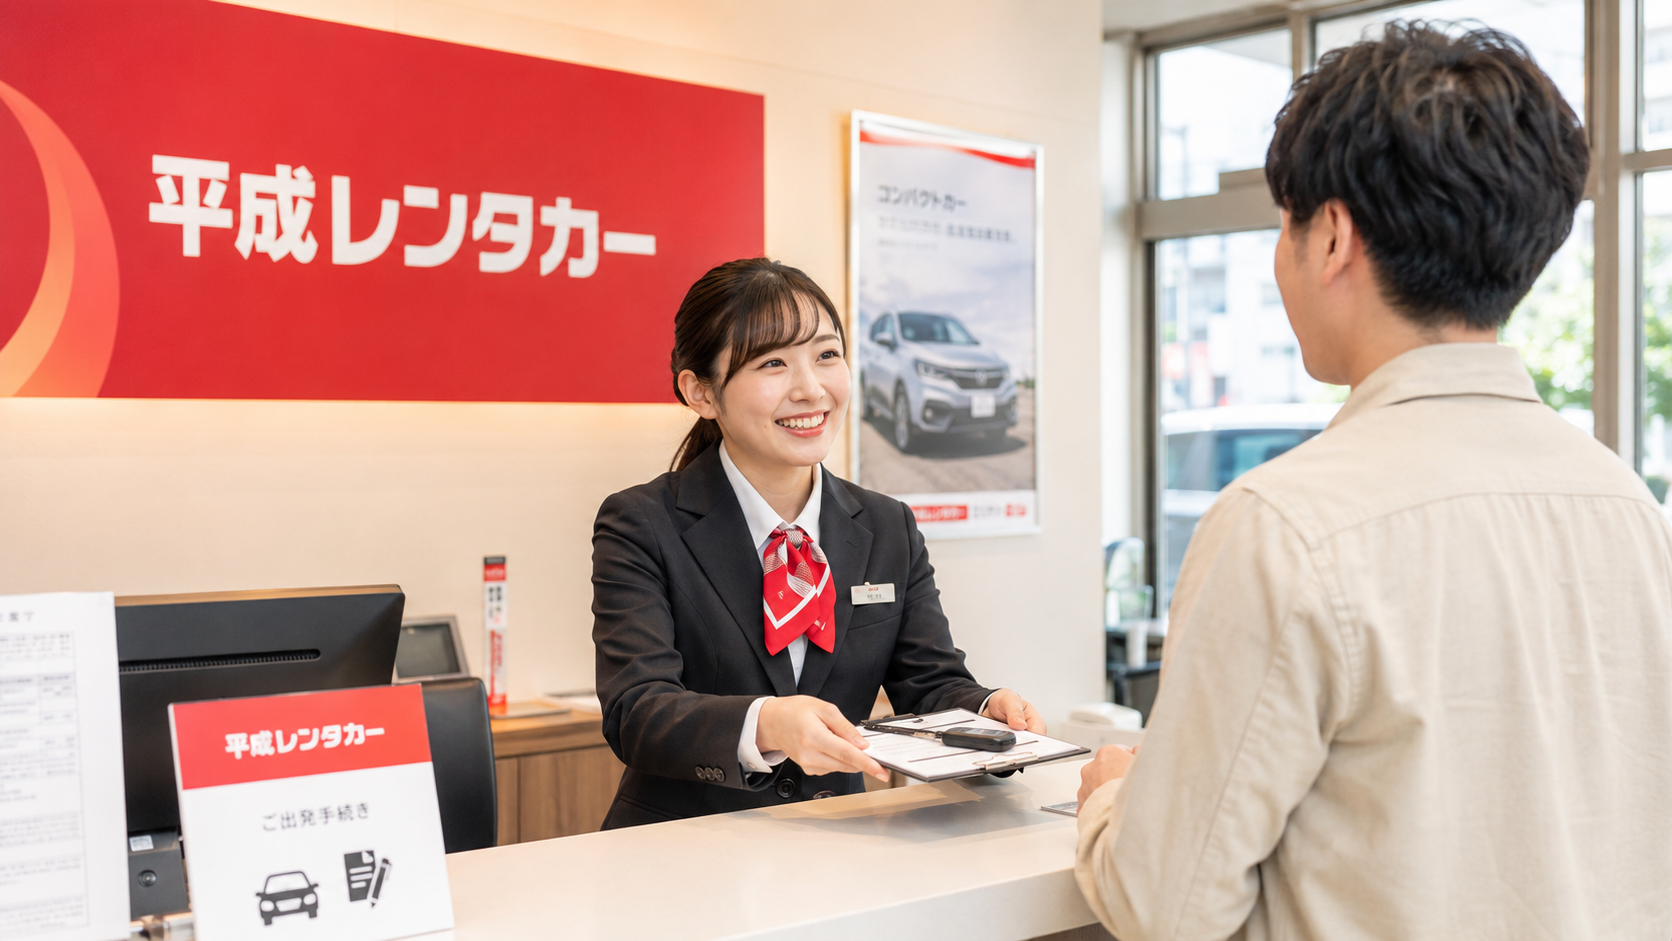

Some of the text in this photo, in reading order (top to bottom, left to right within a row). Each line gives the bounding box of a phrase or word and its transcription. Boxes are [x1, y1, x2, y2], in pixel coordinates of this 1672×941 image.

[878, 184, 967, 212] コンパクトカー
[149, 154, 657, 279] 平成レンタカー
[224, 722, 386, 760] 平成レンタカー
[262, 803, 370, 831] ご出発手続き
